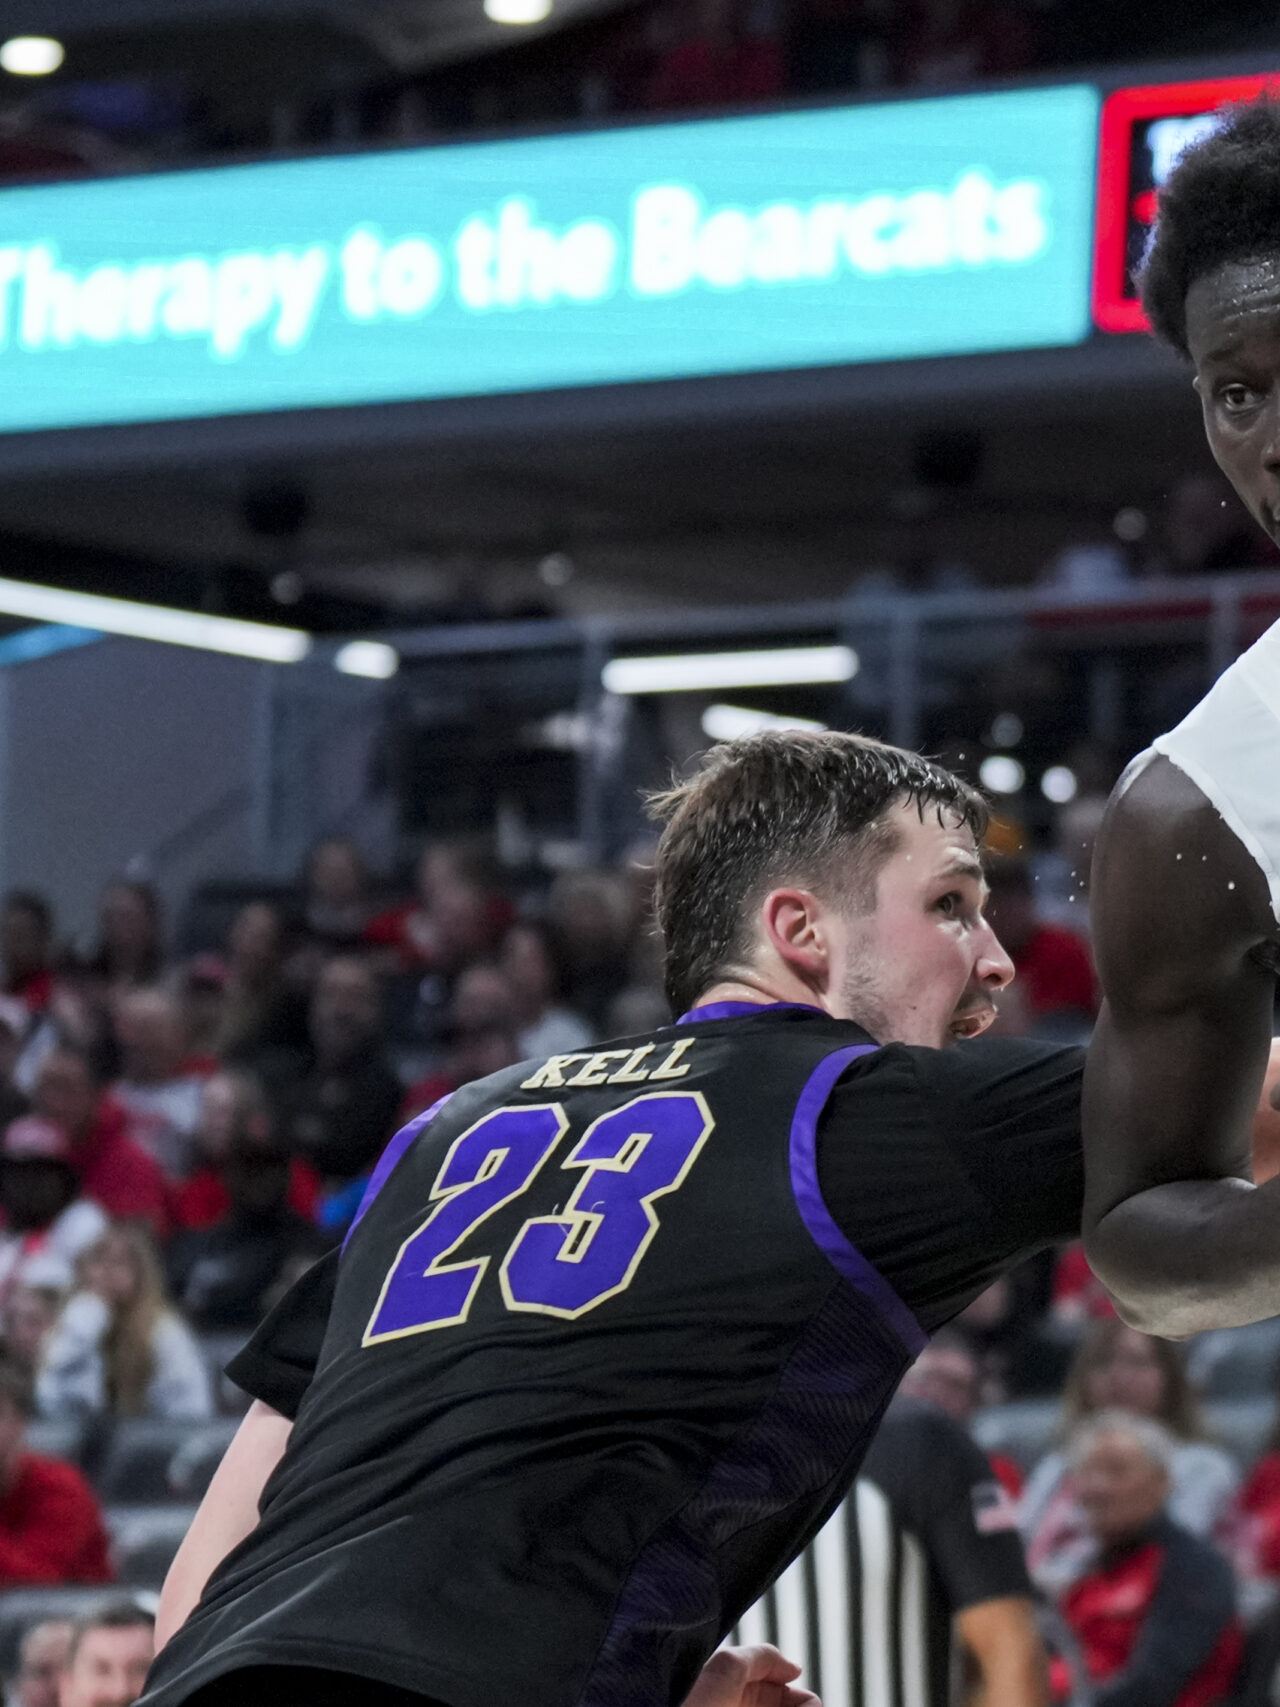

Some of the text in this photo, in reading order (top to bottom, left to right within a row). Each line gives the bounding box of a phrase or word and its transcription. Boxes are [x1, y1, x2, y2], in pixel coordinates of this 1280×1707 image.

[340, 229, 444, 321] to
[455, 200, 619, 311] the
[630, 172, 1049, 296] Bearcats
[519, 1038, 696, 1089] KELL
[362, 1090, 716, 1347] 23
